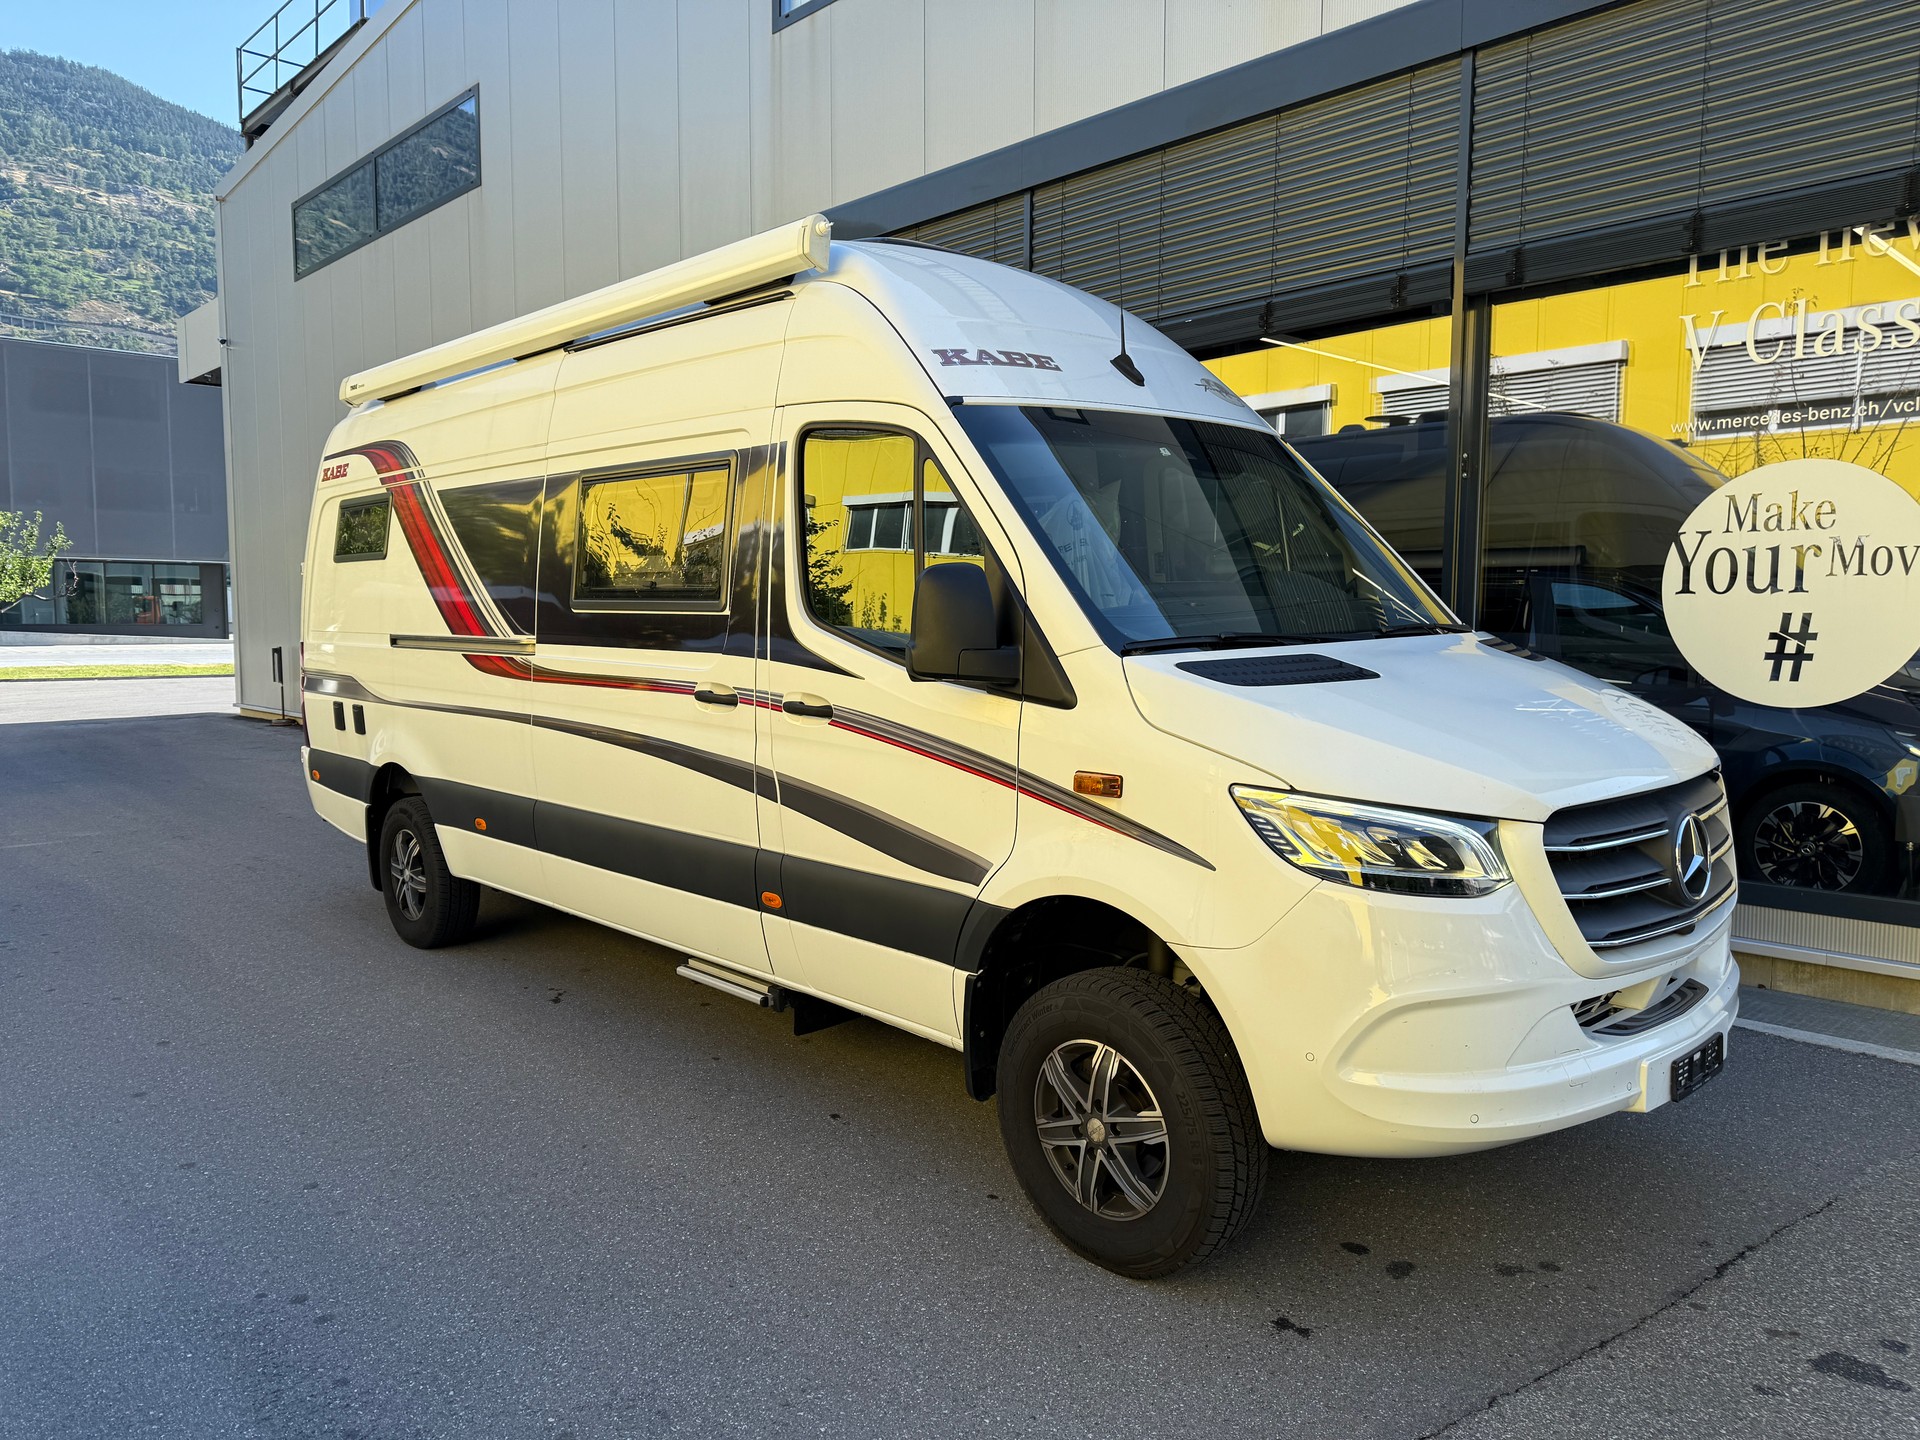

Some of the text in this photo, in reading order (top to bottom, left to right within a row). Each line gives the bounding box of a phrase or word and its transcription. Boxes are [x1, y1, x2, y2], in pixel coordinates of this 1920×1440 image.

[931, 349, 1063, 372] KABE
[1671, 396, 1920, 433] www.mercedes-benz.ch/vcl
[321, 463, 350, 482] KABE
[1722, 490, 1837, 534] Make
[1673, 530, 1920, 595] Your Mov
[1176, 1091, 1198, 1136] 225/75
